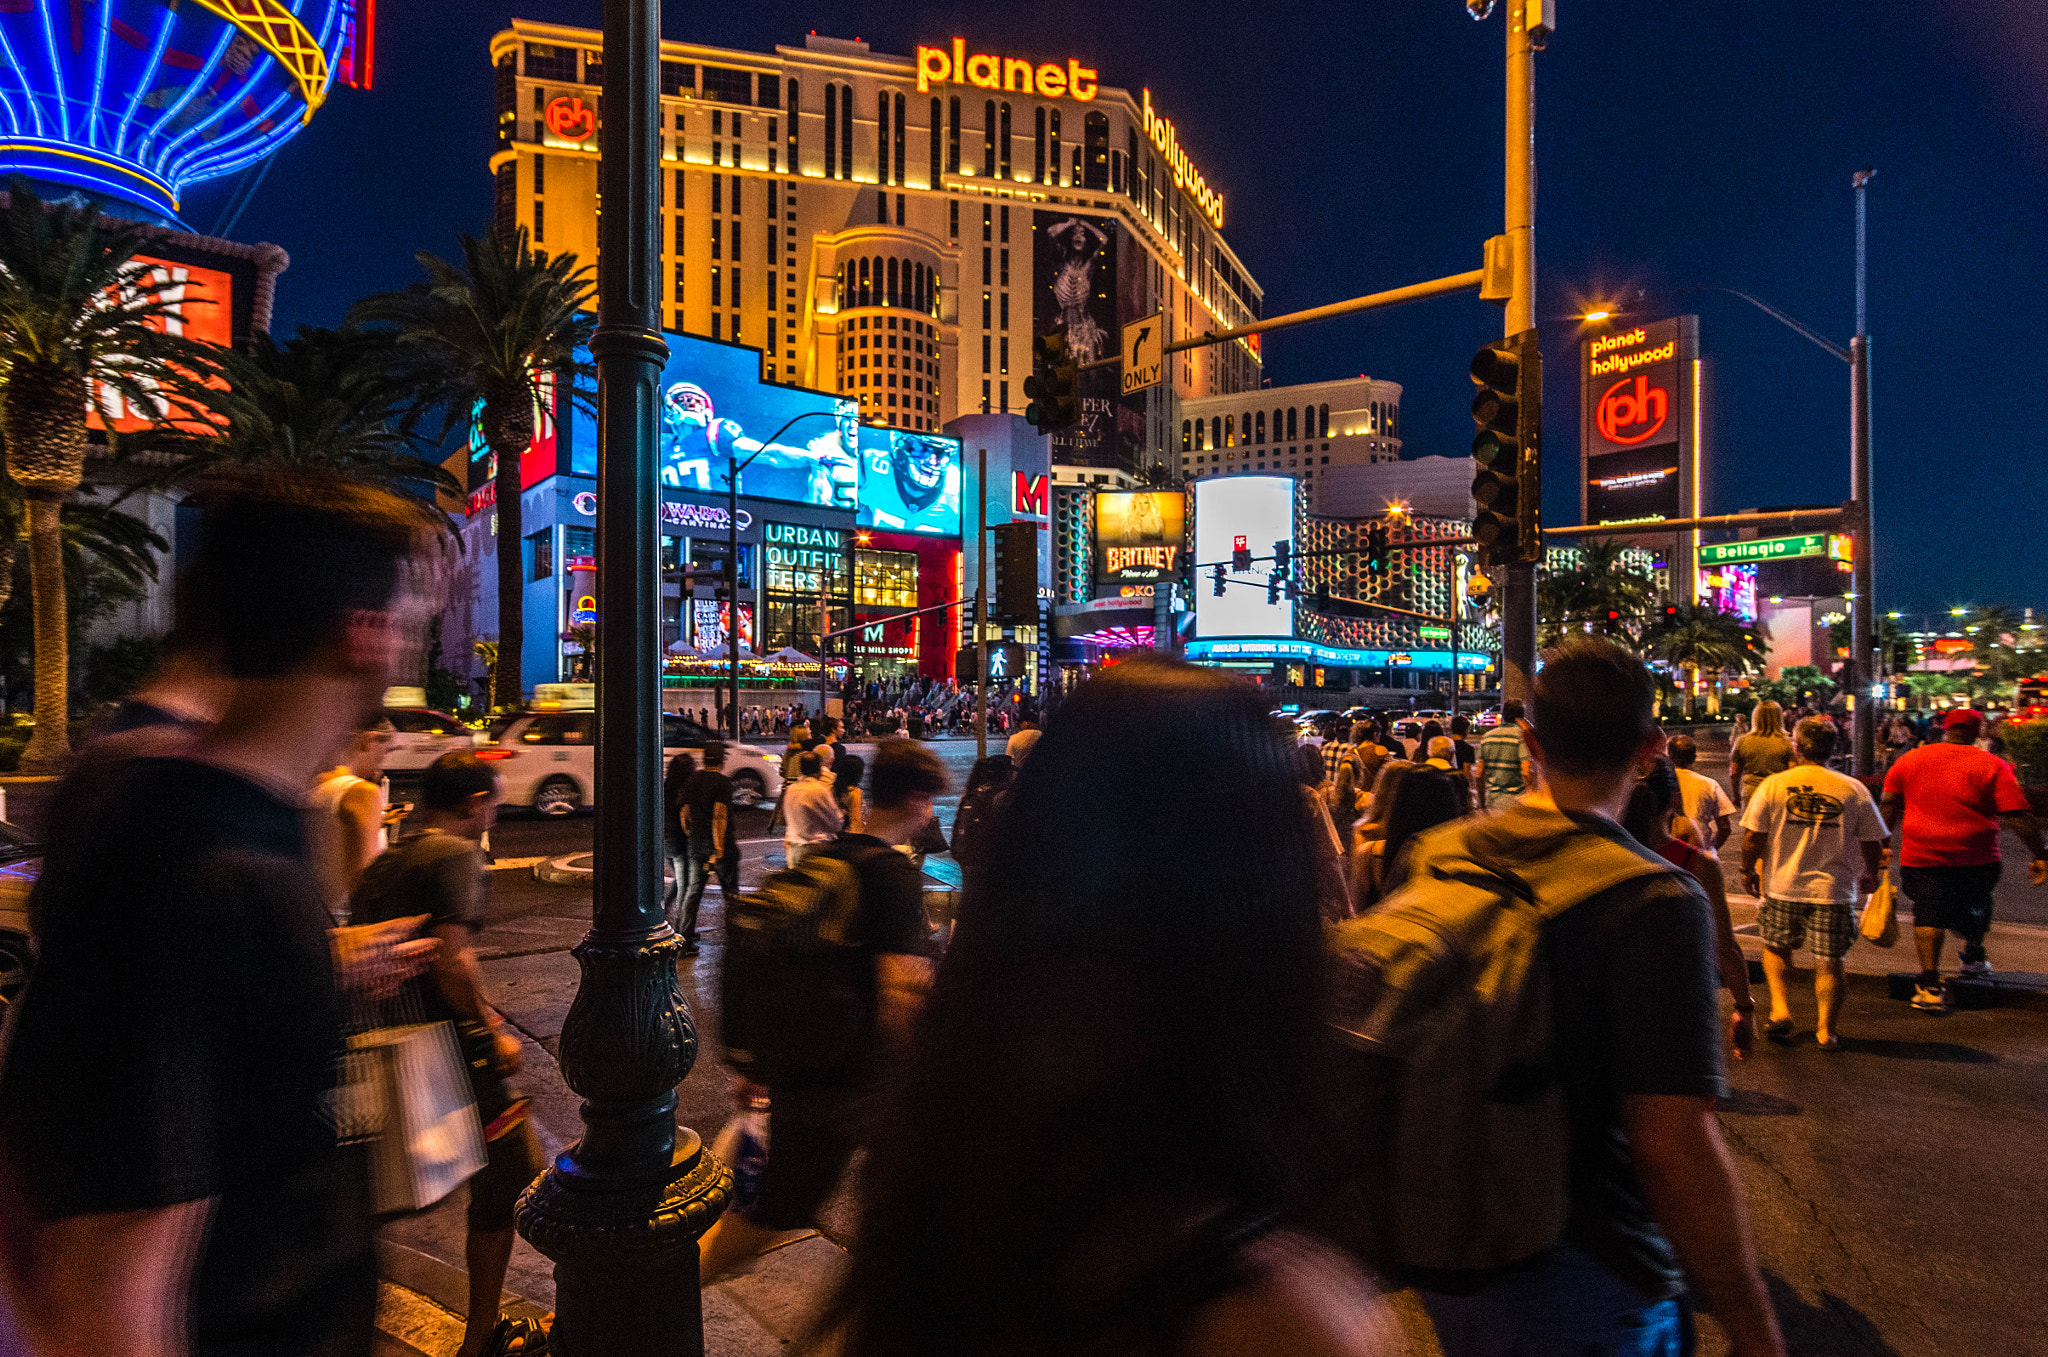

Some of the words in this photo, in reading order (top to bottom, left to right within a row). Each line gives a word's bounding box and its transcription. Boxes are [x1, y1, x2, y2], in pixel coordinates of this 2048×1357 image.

[917, 36, 1098, 102] planet
[547, 97, 594, 140] ph
[1142, 86, 1224, 229] hollywood
[1590, 328, 1647, 358] planet
[1590, 341, 1675, 376] hollywood
[1125, 363, 1160, 389] ONLY
[1598, 375, 1668, 442] ph
[1011, 471, 1049, 517] M
[672, 518, 725, 530] CANTINA
[766, 524, 839, 548] URBAN
[766, 547, 842, 570] OUTFIT
[1106, 545, 1177, 573] BRITNEY
[1717, 542, 1785, 558] Bellagio
[766, 569, 817, 590] TERS
[864, 623, 884, 642] M
[867, 646, 886, 654] MILE
[888, 647, 913, 655] SHOPS
